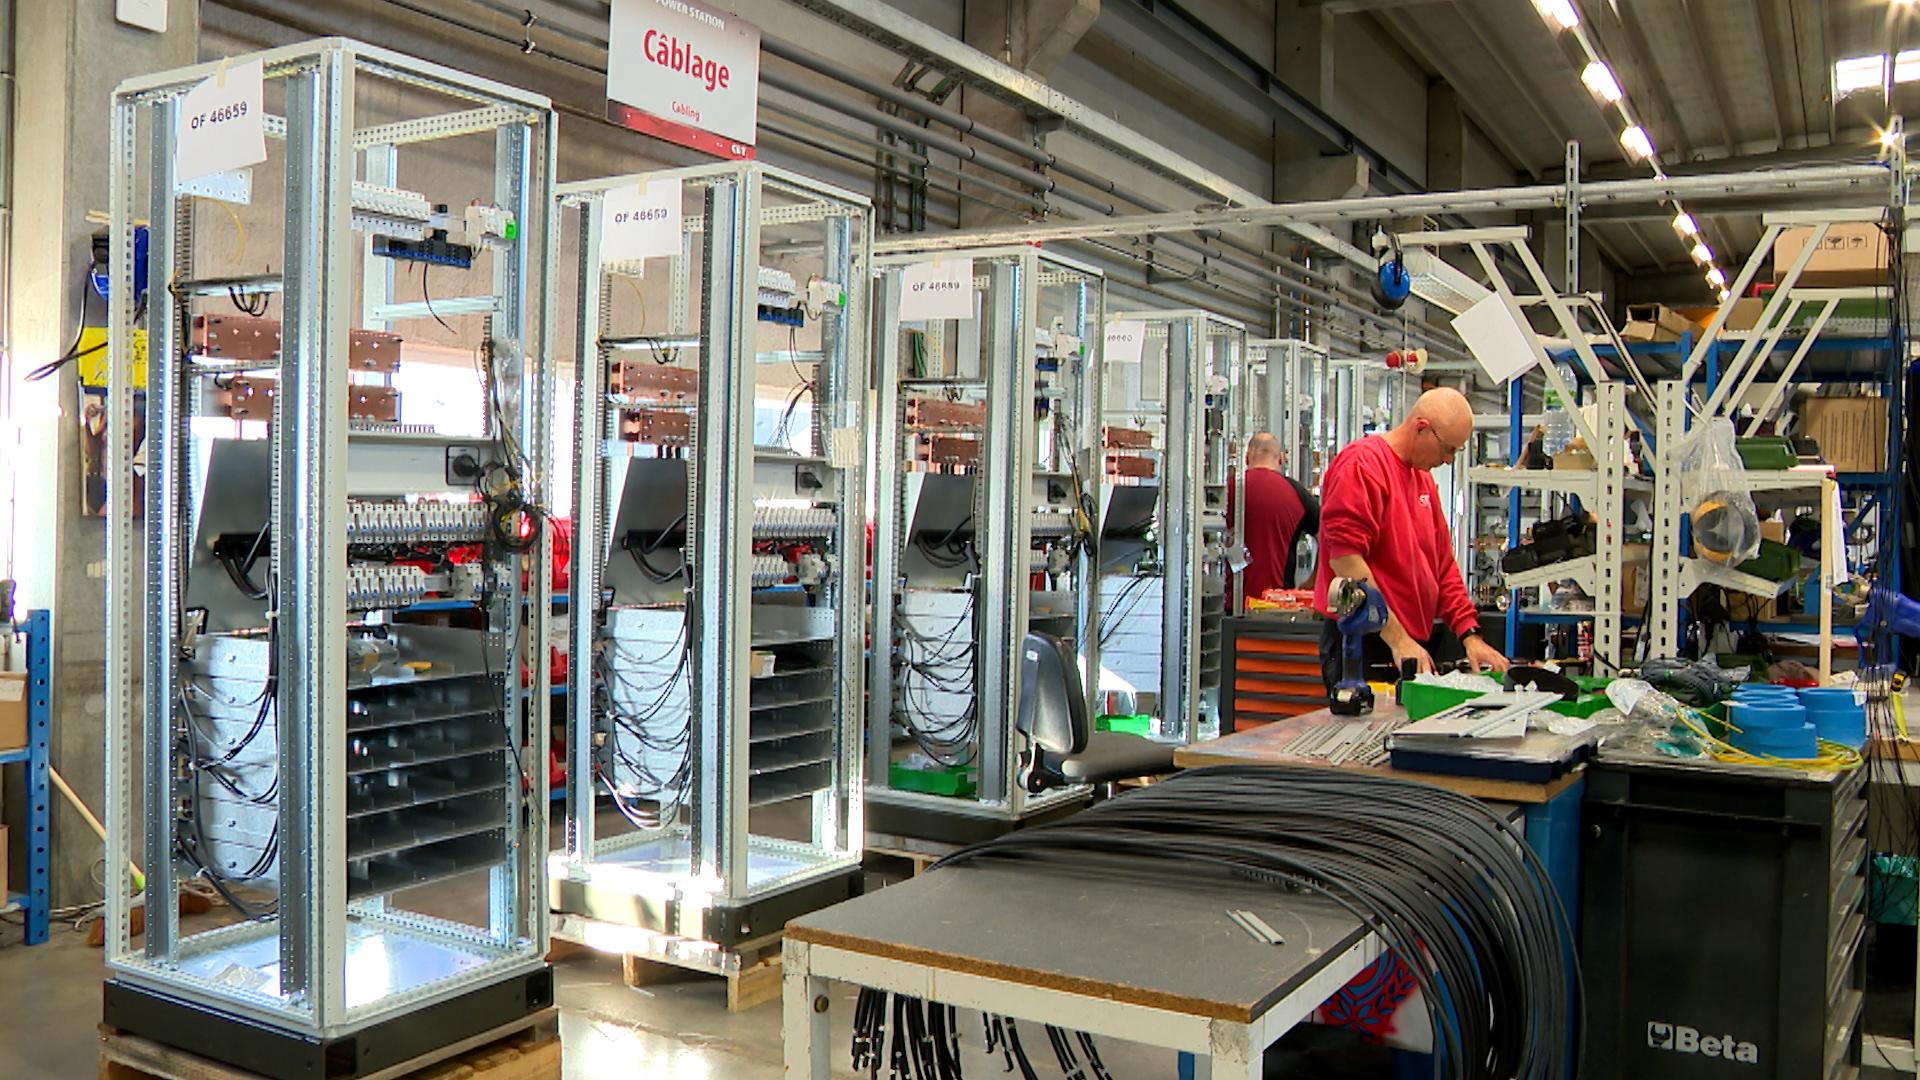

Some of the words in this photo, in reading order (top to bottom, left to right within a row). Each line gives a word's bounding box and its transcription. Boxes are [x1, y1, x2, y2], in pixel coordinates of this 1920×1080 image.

[689, 7, 725, 31] STATION
[643, 29, 730, 92] Câblage
[191, 113, 205, 129] OF
[209, 101, 248, 123] 46659
[672, 101, 701, 122] Cabling
[614, 212, 629, 223] OF
[1675, 1025, 1758, 1064] Beta
